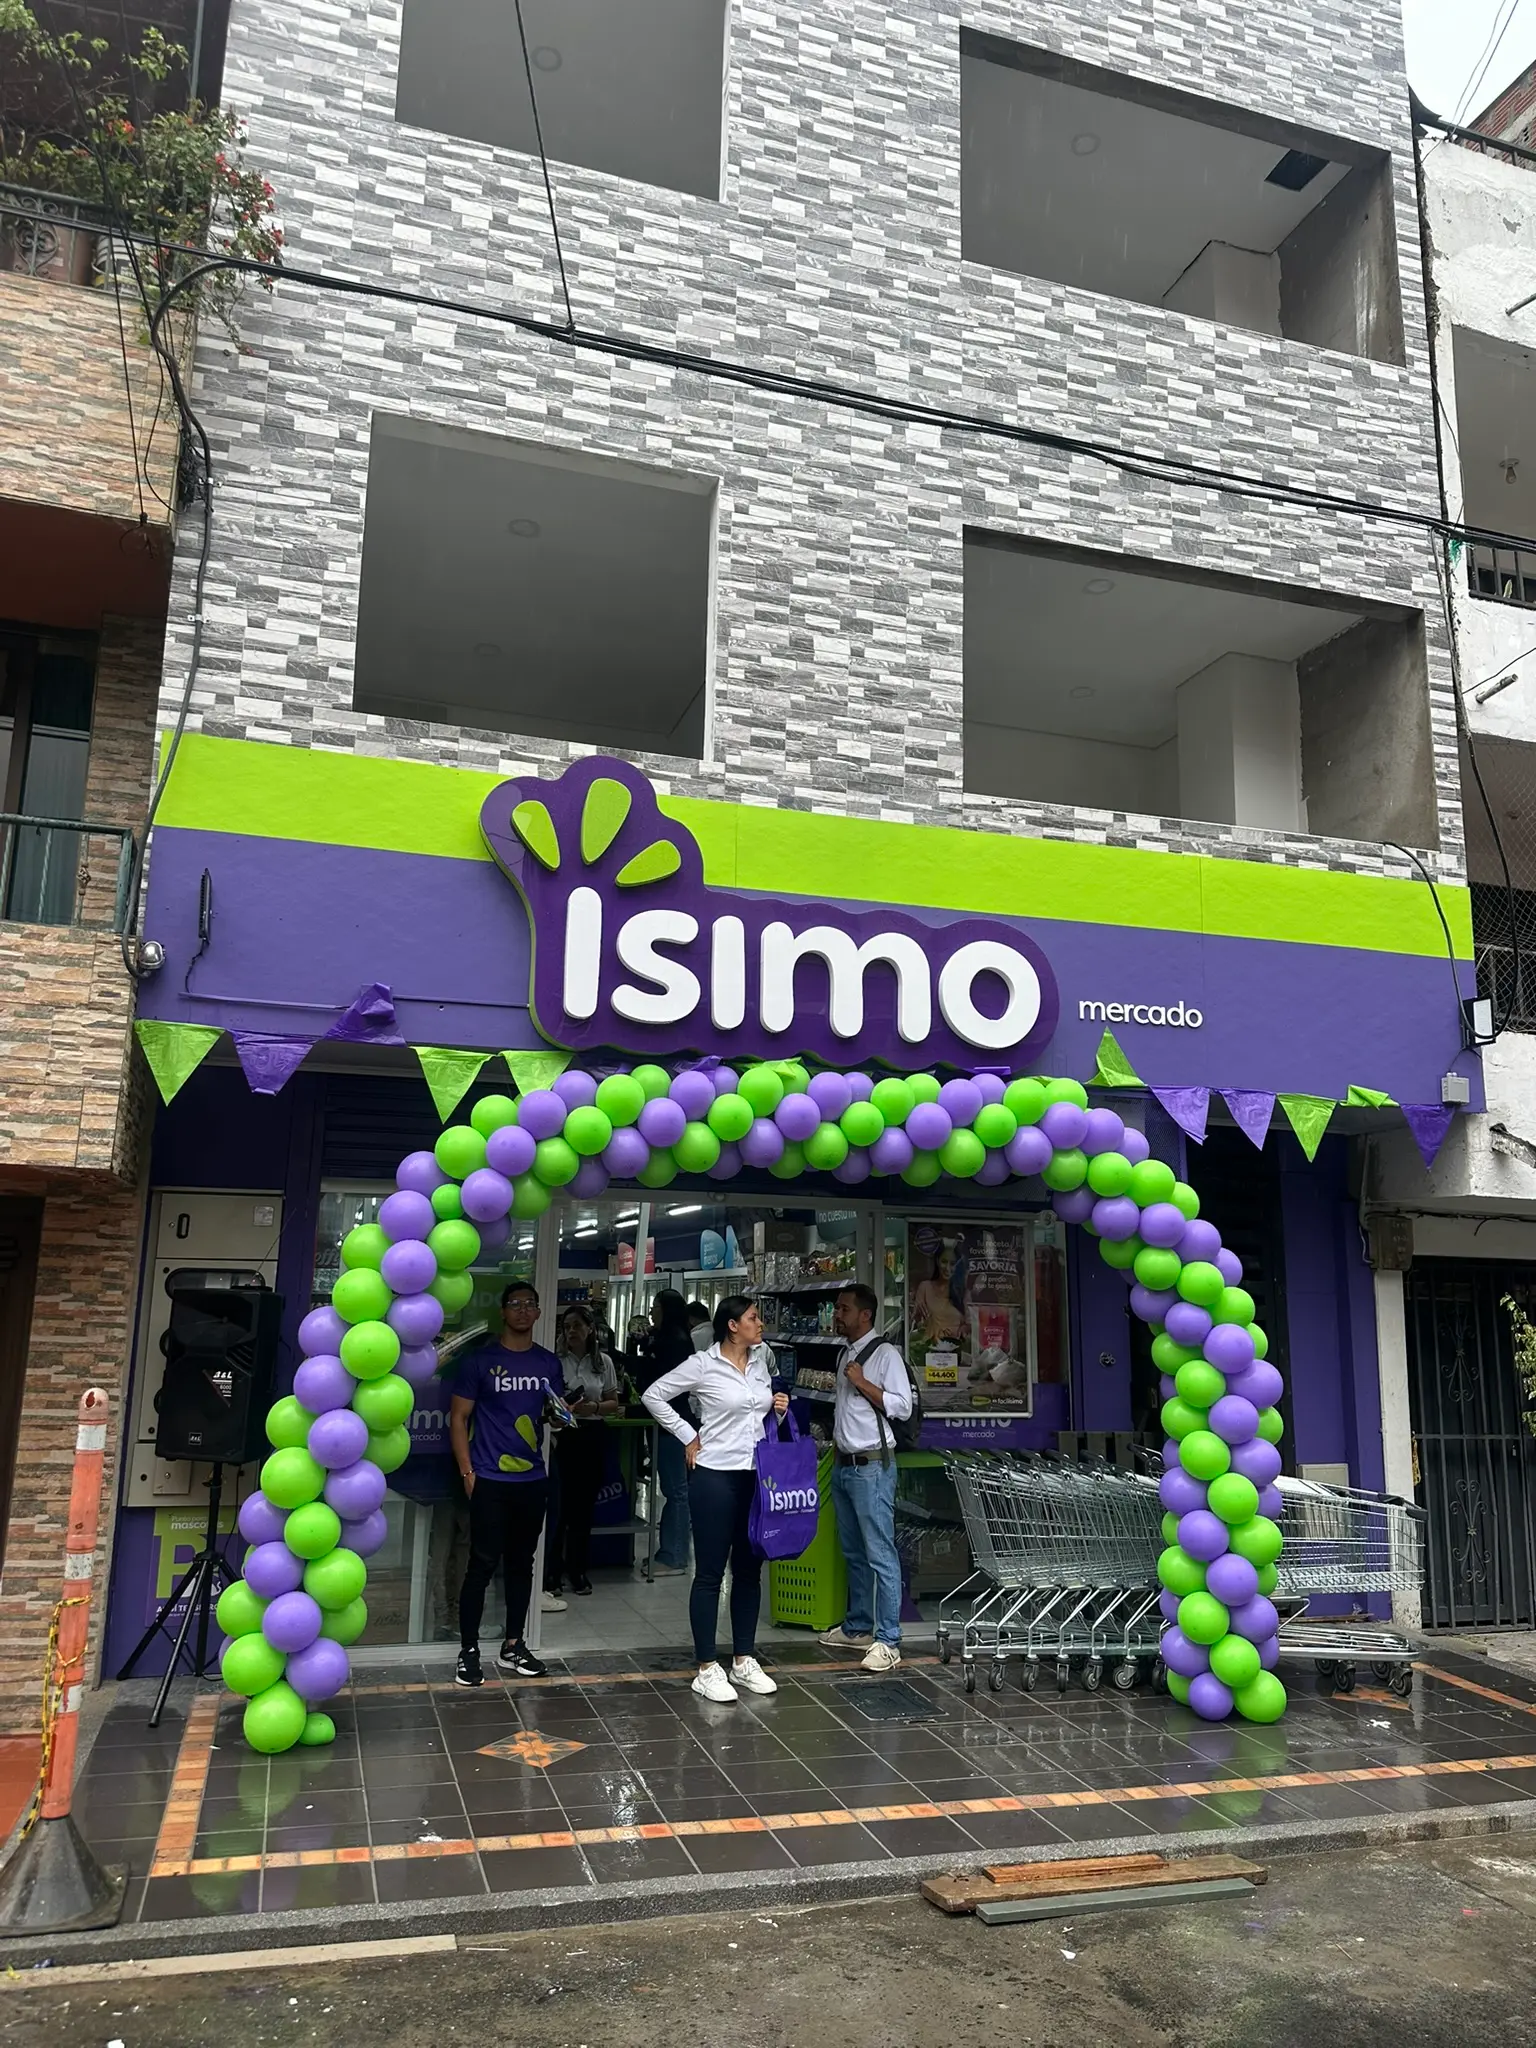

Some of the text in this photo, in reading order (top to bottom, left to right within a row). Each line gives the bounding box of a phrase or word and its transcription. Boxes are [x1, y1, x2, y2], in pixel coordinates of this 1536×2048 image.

[1079, 1000, 1203, 1028] mercado
[411, 1432, 441, 1441] ercado
[962, 1430, 995, 1438] mercado
[171, 1521, 224, 1530] mascos
